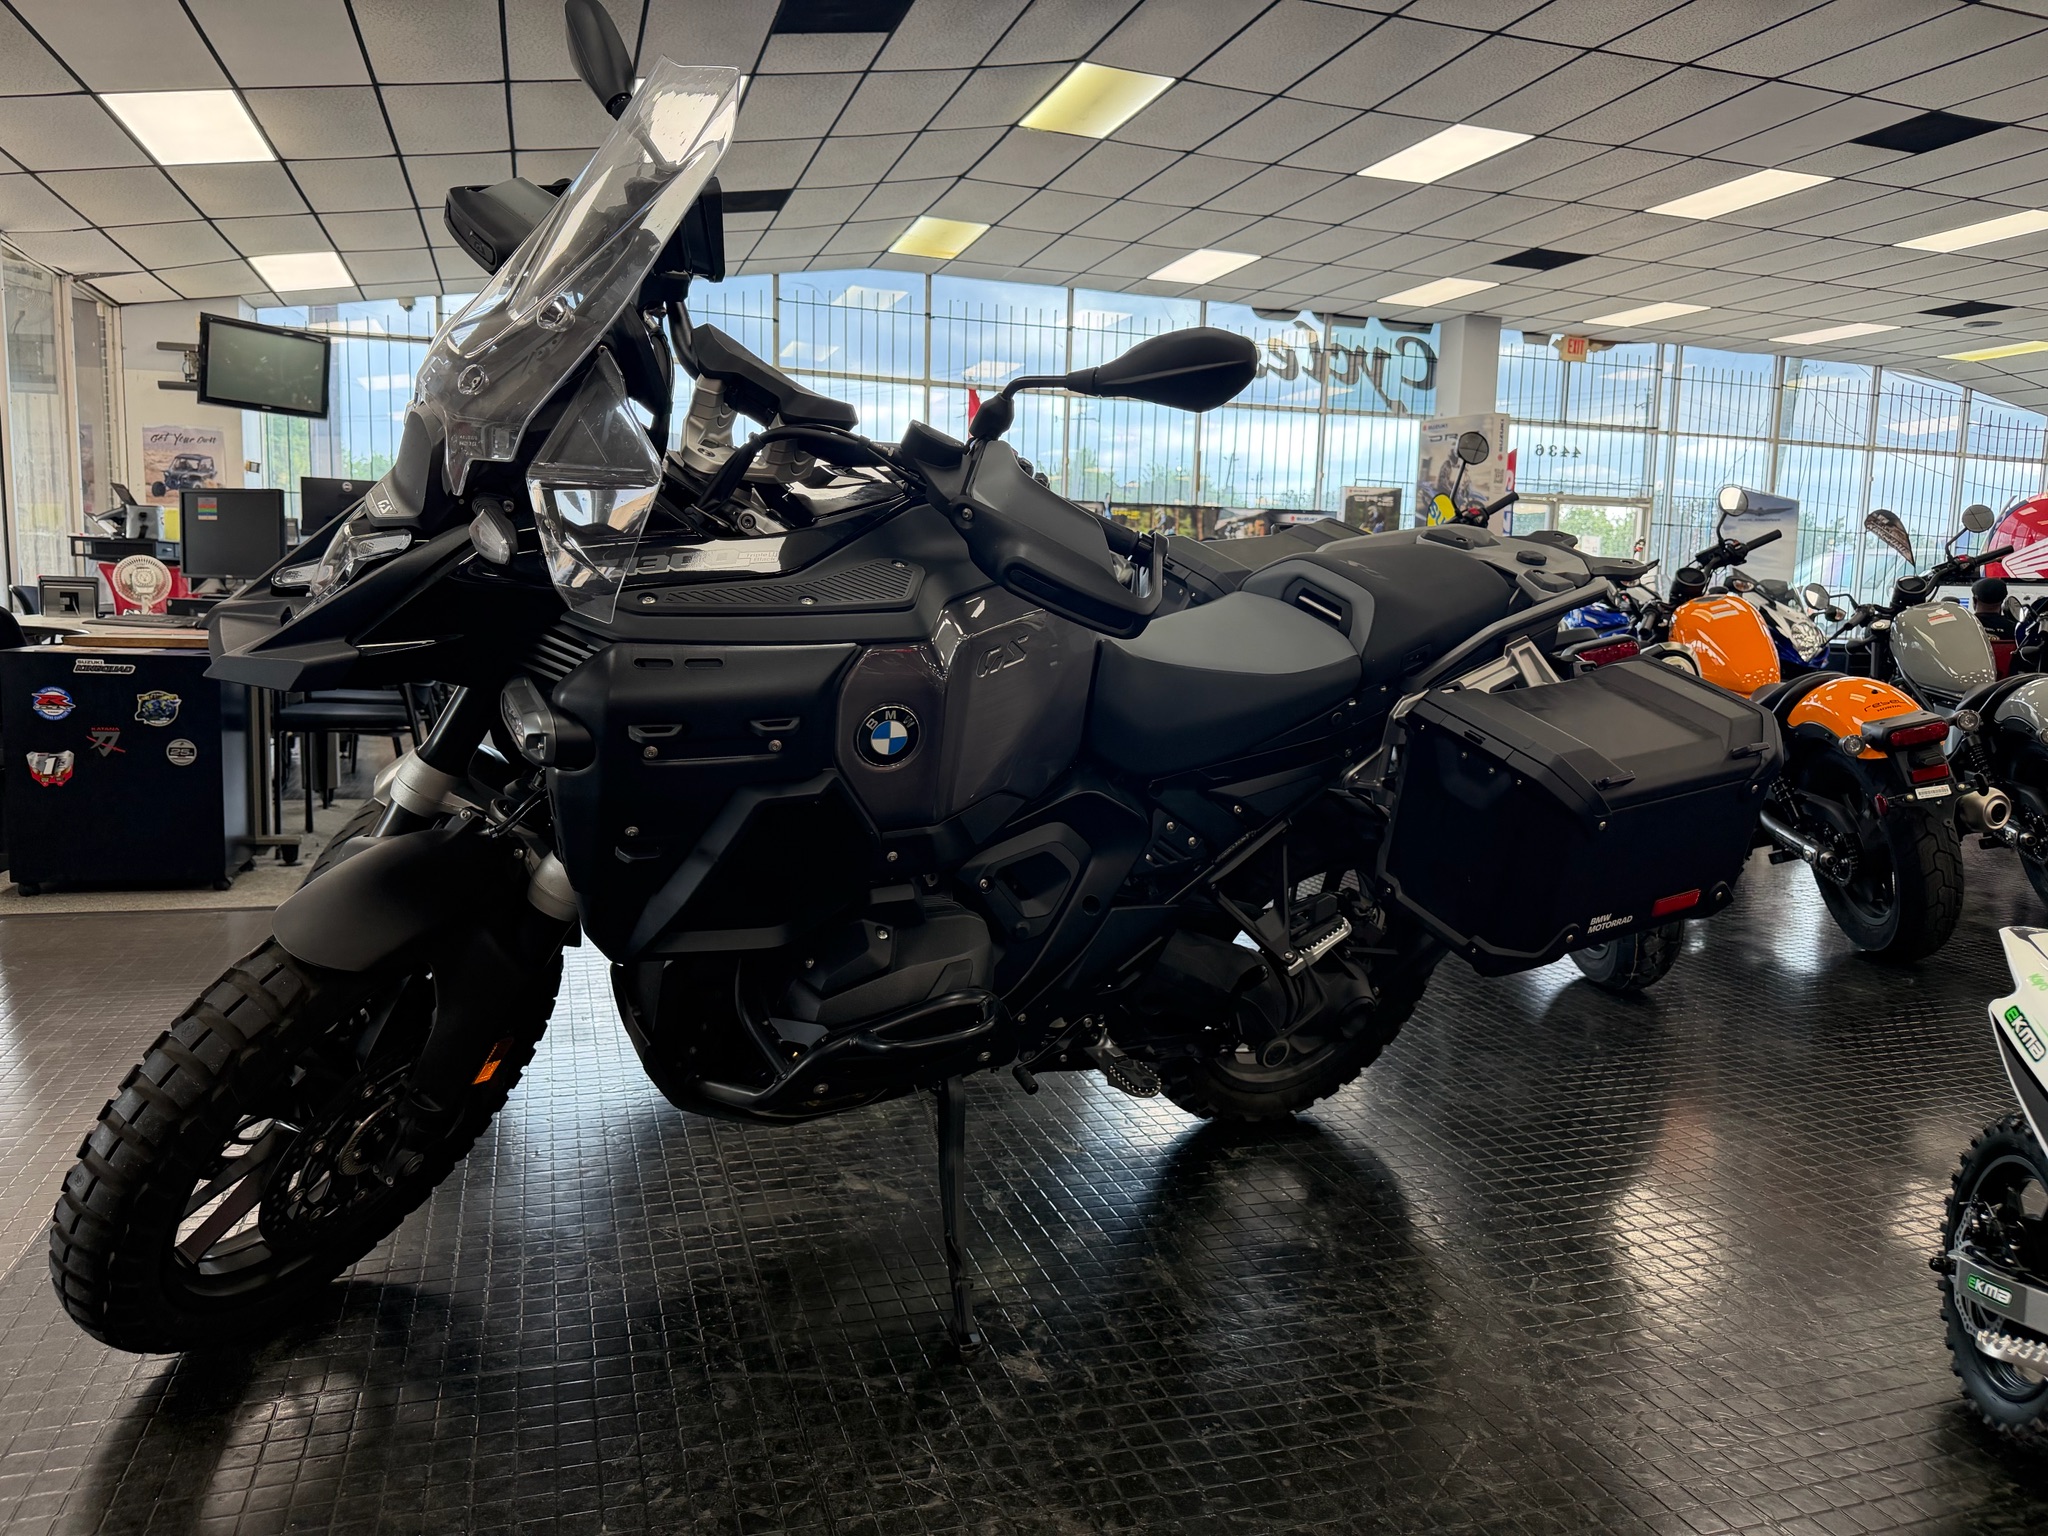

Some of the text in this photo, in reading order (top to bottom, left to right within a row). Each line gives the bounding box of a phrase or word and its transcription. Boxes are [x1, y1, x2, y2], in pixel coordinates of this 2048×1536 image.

[1567, 338, 1585, 355] EXIT
[865, 710, 916, 731] BMW
[1587, 915, 1633, 934] MOTORRAD
[1590, 913, 1612, 926] BMW
